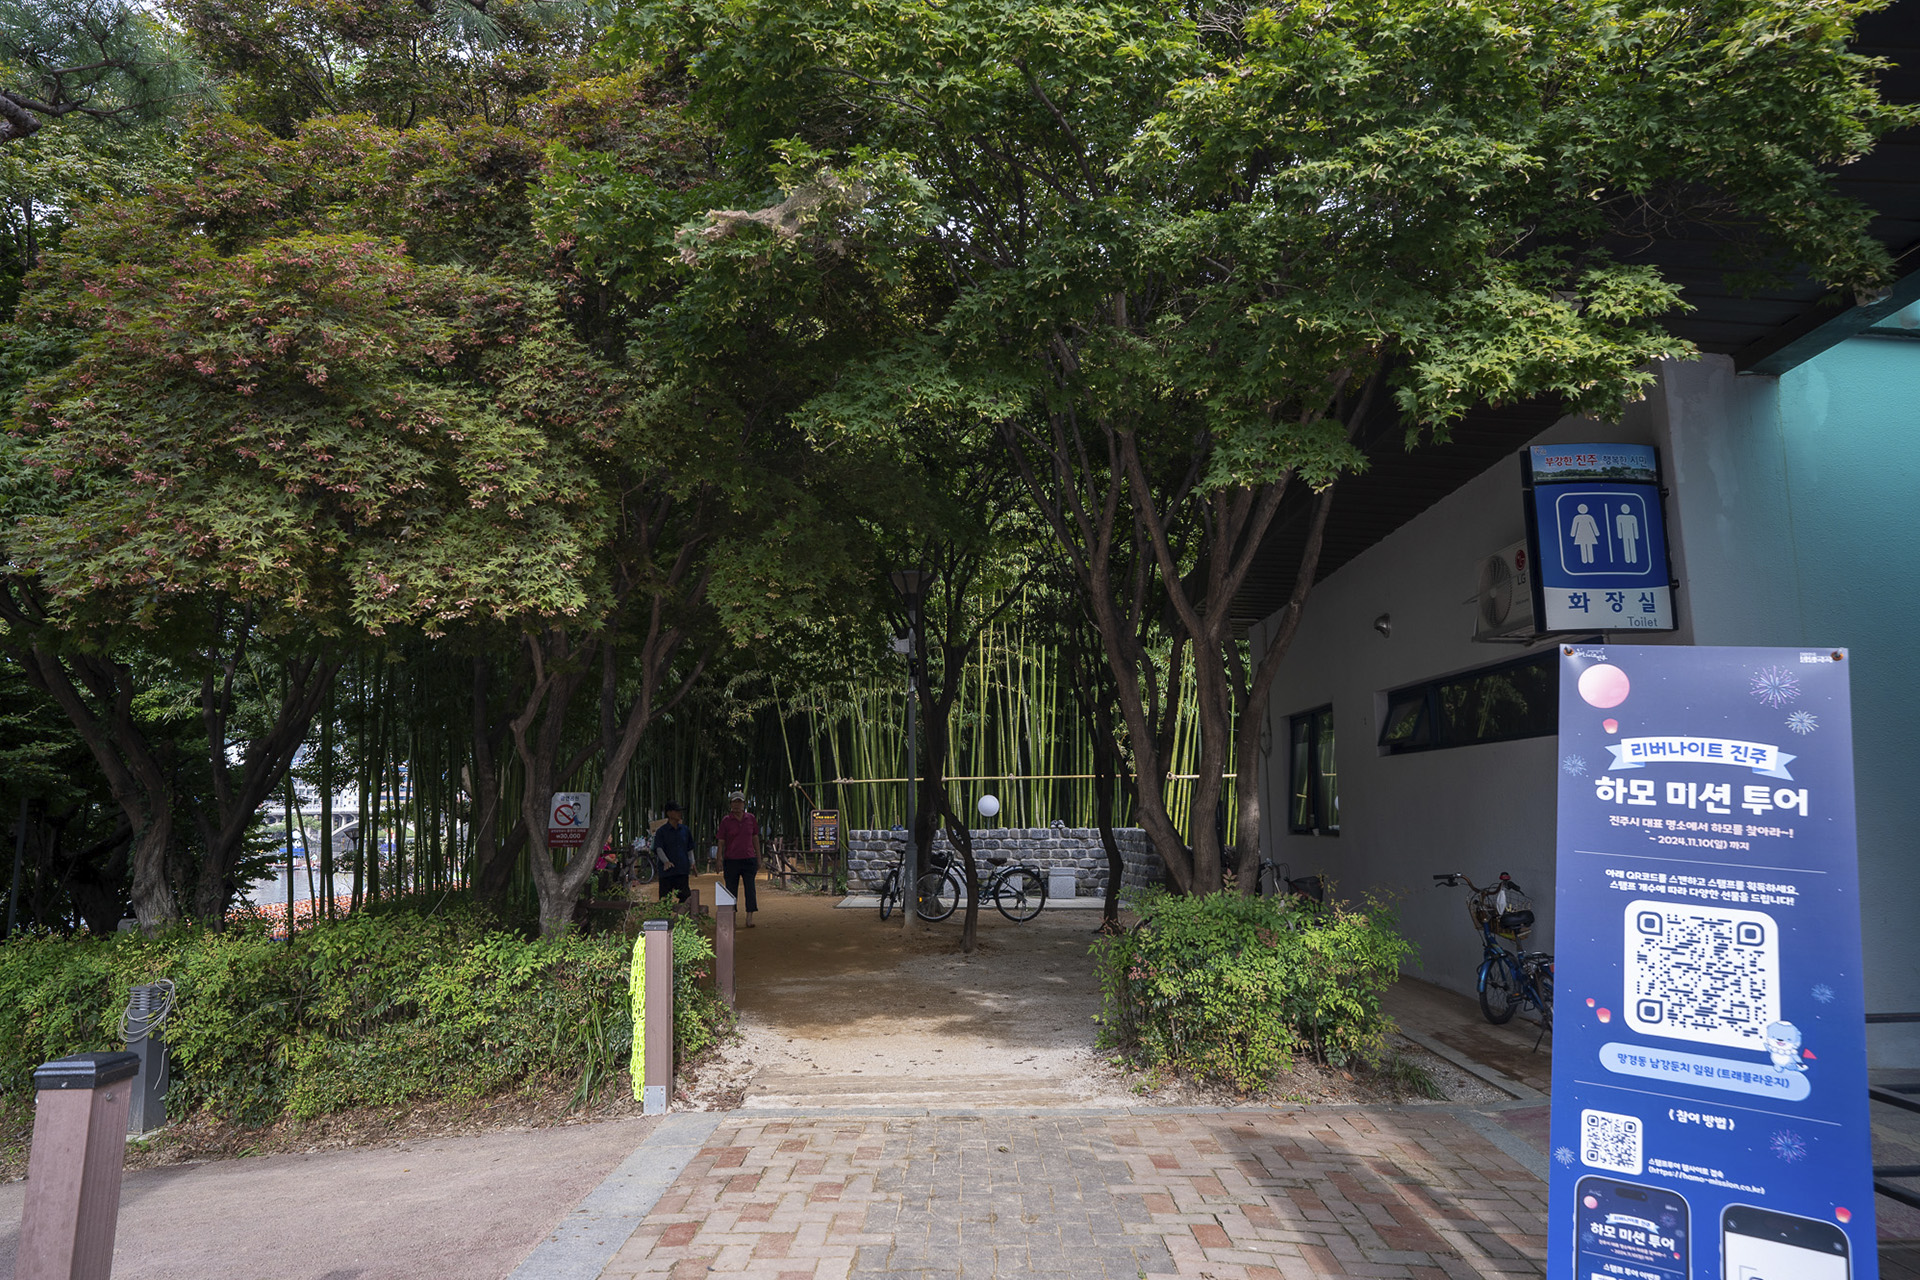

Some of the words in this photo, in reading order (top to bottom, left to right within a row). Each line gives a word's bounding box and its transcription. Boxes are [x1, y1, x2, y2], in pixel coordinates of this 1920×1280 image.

[1545, 456, 1572, 467] 부강한
[1575, 454, 1598, 466] 진주
[1602, 455, 1627, 466] 행복한
[1630, 455, 1647, 467] 시민
[1517, 574, 1526, 585] LG
[1627, 616, 1658, 628] Toilet
[1630, 741, 1724, 758] 리버나이트
[1730, 744, 1768, 764] 진주
[1595, 776, 1657, 806] 하모
[1666, 782, 1730, 814] 미션
[1741, 785, 1808, 816] 투어
[1609, 815, 1640, 826] 진주시
[1642, 818, 1663, 828] 대표
[1665, 820, 1708, 832] 명소에서
[1710, 823, 1743, 836] 하모를
[1746, 825, 1794, 838] 찾아라~!
[1658, 835, 1728, 850] 2024.11.10(일)
[1729, 841, 1749, 851] 까지
[1605, 869, 1625, 878] 아래
[1626, 871, 1667, 883] QR코드를
[1669, 875, 1706, 886] 스캔하고
[1707, 878, 1745, 890] 스탬프를
[1609, 880, 1636, 891] 스탬프
[1638, 883, 1666, 893] 개수에
[1667, 886, 1688, 895] 따라
[1689, 888, 1719, 899] 다양한
[1721, 891, 1749, 902] 선물을
[1750, 893, 1795, 906] 드립니다!
[1617, 1053, 1647, 1067] 망경동
[1650, 1058, 1690, 1073] 남강둔치
[1693, 1064, 1714, 1077] 일원
[1717, 1068, 1790, 1089] (트래블라운지)
[1590, 1222, 1616, 1238] 하모
[1619, 1228, 1646, 1246] 미션
[1648, 1234, 1675, 1252] 투어
